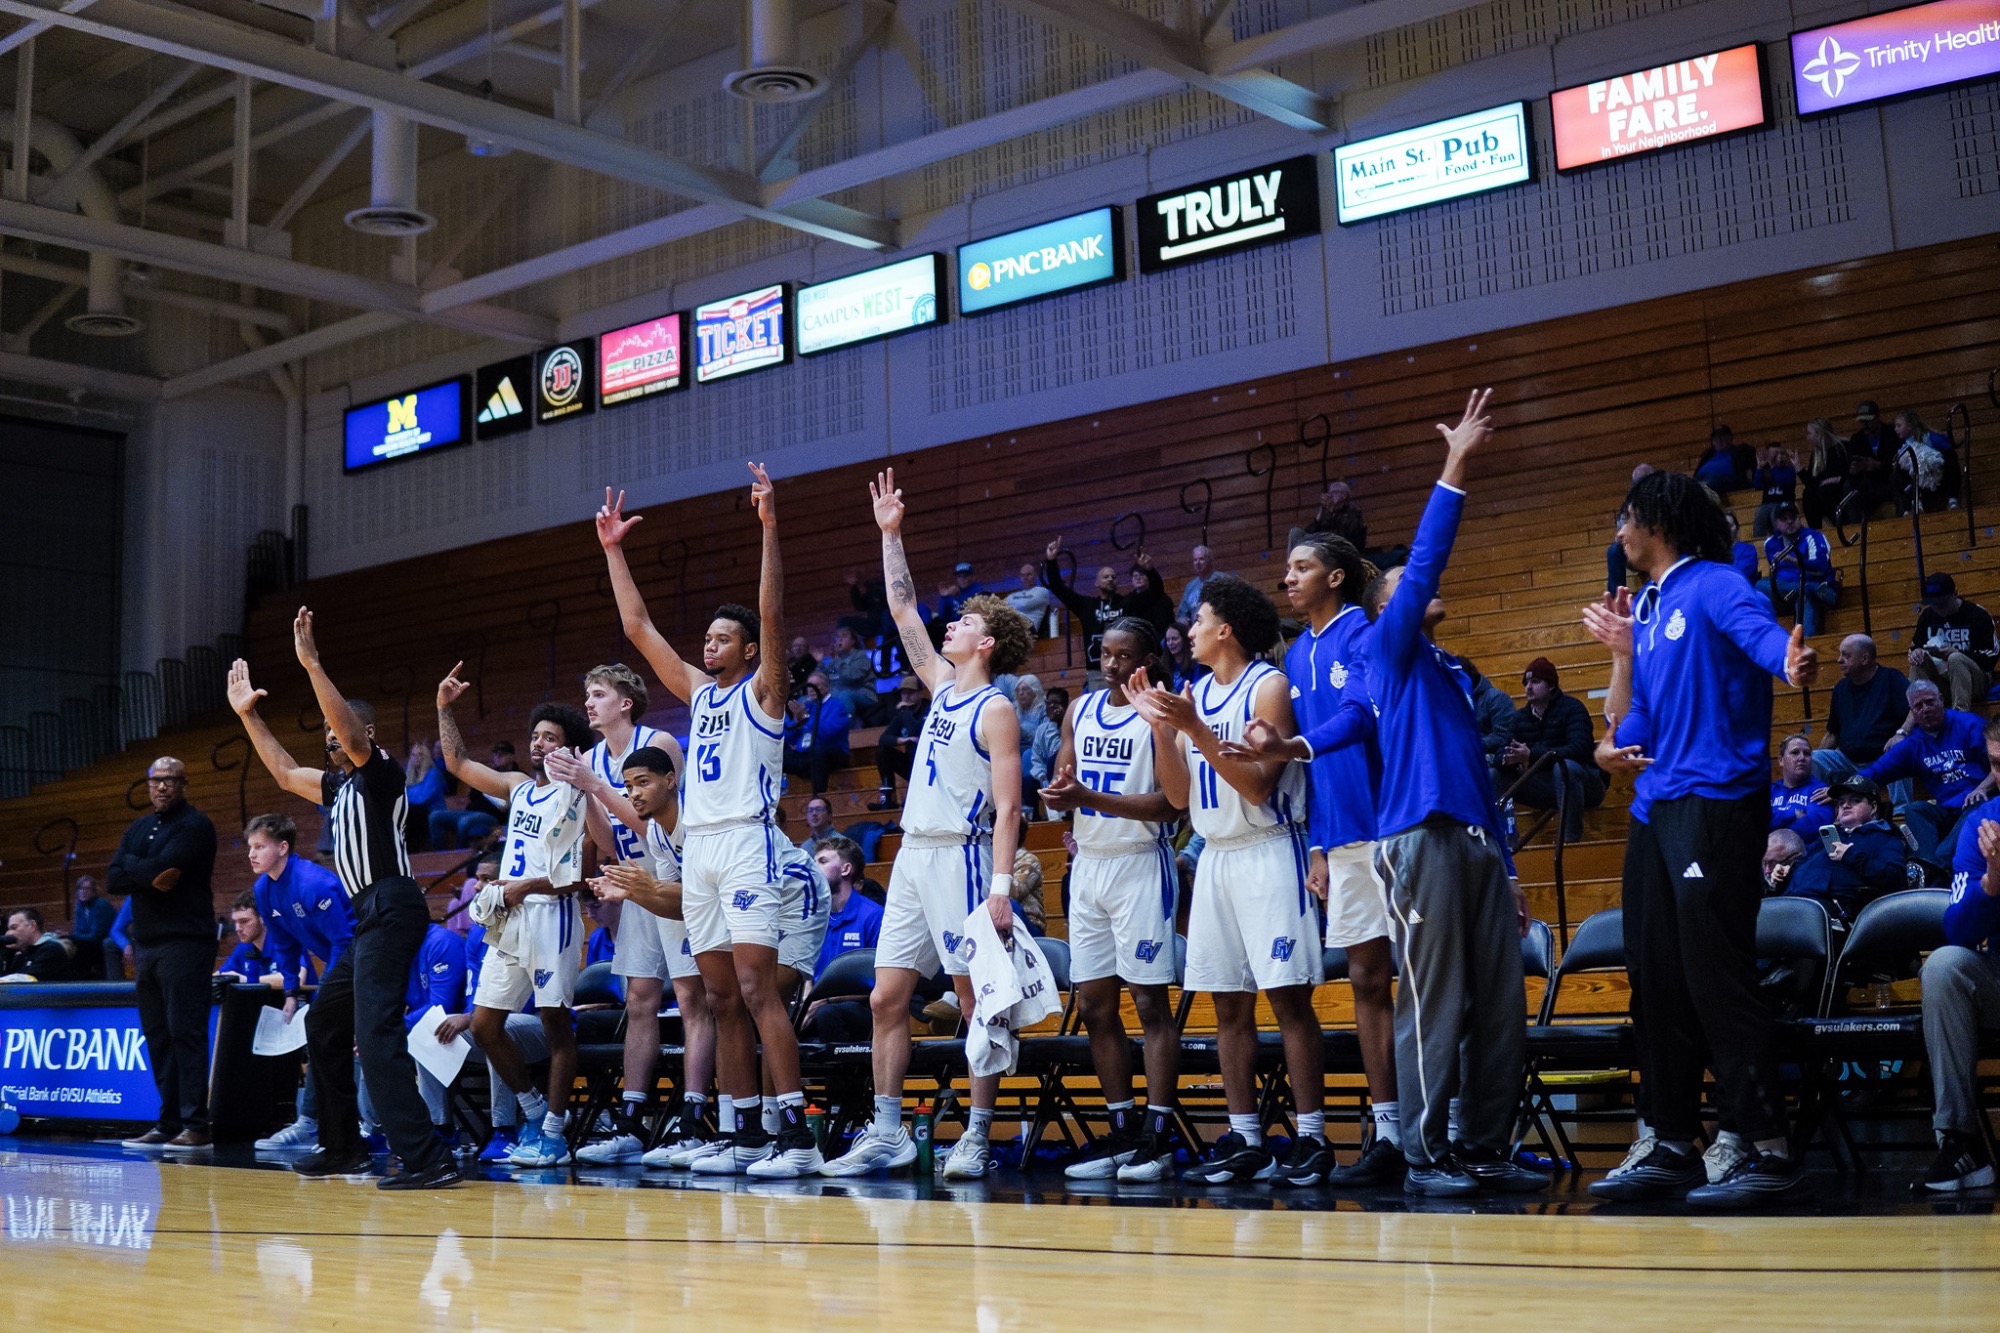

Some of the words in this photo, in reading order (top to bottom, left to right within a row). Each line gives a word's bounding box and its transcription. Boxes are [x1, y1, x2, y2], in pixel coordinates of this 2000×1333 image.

[1863, 39, 1932, 68] Trinity
[1587, 53, 1719, 114] FAMILY
[1350, 156, 1397, 181] Main
[1405, 147, 1431, 167] St.
[1442, 129, 1499, 162] Pub
[1601, 146, 1612, 158] In
[1613, 141, 1636, 155] Your
[1638, 120, 1717, 151] Neighborhood
[1444, 158, 1478, 176] Food
[1489, 152, 1516, 166] Fun
[1157, 169, 1282, 241] TRULY
[803, 303, 860, 331] CAMPUS
[862, 286, 902, 319] WEST
[697, 303, 783, 364] TICKET
[633, 348, 675, 370] PIZZA
[553, 363, 571, 392] JJ
[387, 394, 417, 434] M
[696, 742, 721, 783] 15
[1083, 735, 1134, 761] GVSU
[1199, 760, 1219, 810] 11
[509, 839, 526, 877] 3
[1135, 939, 1163, 964] GV
[1270, 935, 1297, 963] GV
[1814, 1021, 1900, 1035] gvsulakers.com
[28, 1086, 49, 1101] Bank
[50, 1087, 60, 1102] of
[60, 1087, 85, 1102] GVSU
[84, 1088, 122, 1104] Athletics
[914, 1125, 928, 1141] G
